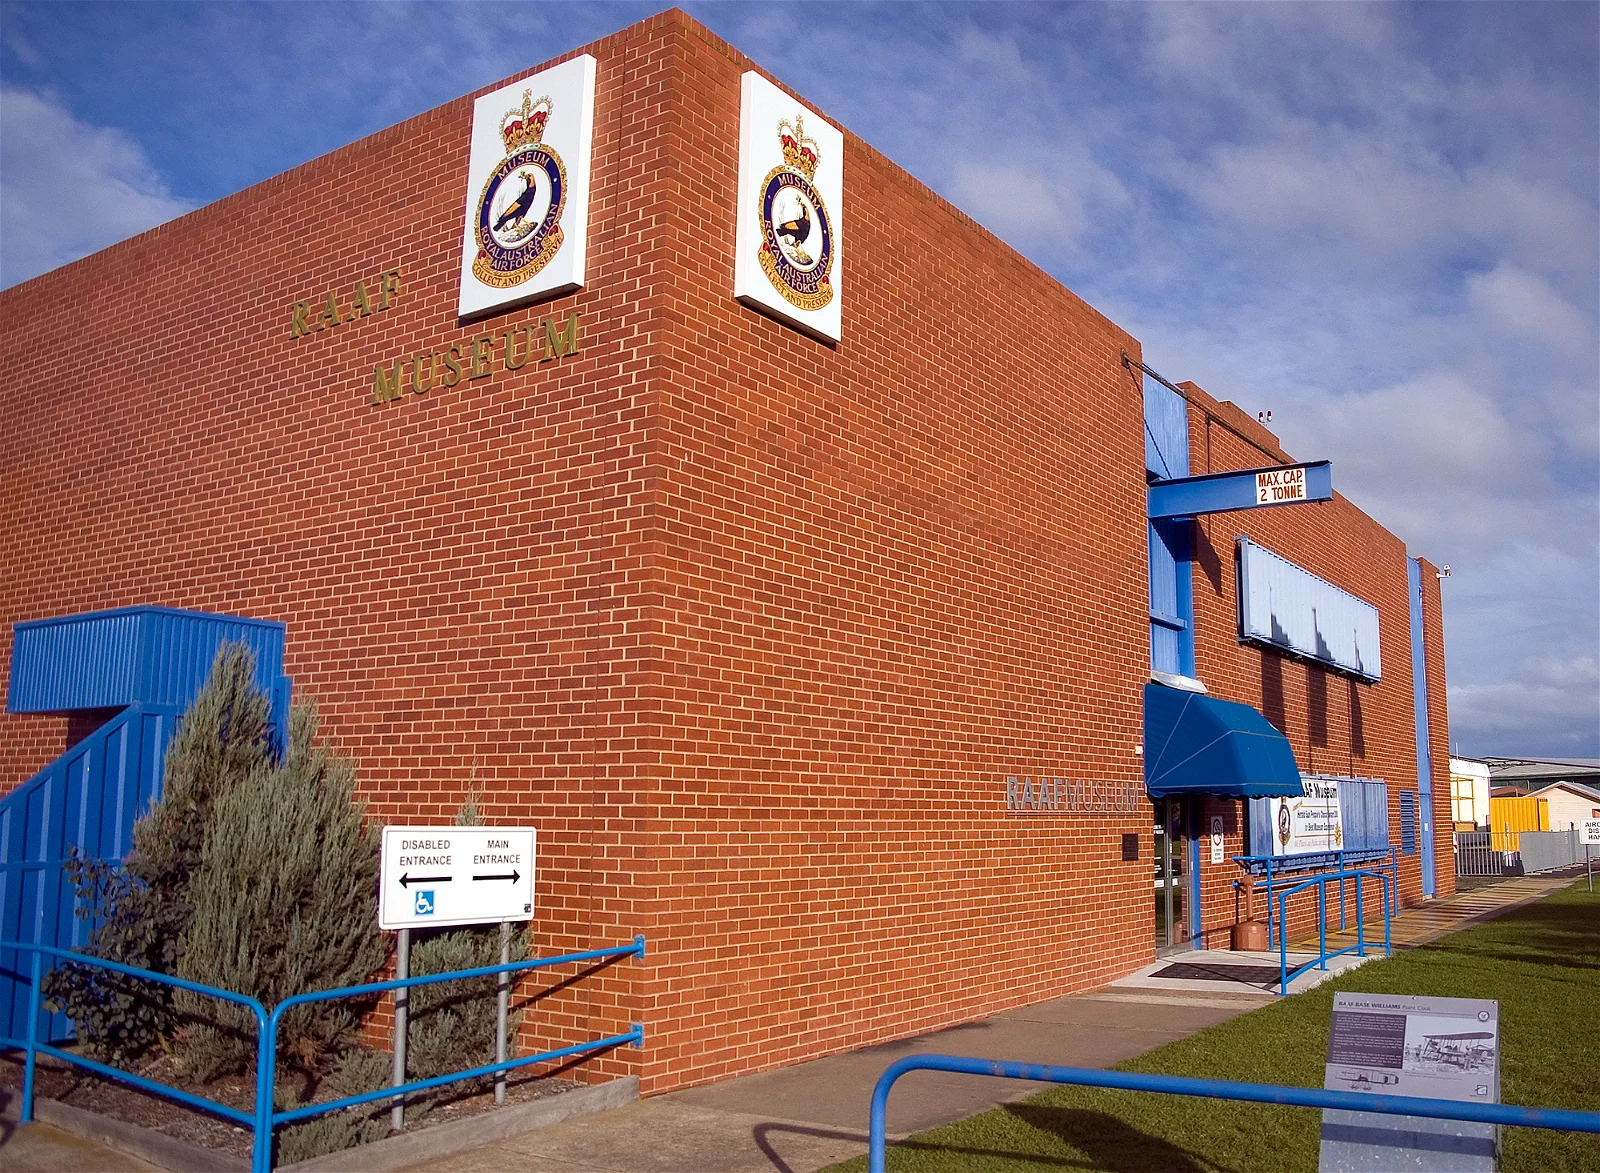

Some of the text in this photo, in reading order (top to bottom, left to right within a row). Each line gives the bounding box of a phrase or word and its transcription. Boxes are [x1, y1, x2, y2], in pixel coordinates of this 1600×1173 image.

[498, 151, 550, 181] MUSEUM
[778, 175, 821, 211] MUSEUM
[481, 203, 558, 261] ROYAL AUSTRALIAN
[472, 235, 564, 287] COLLECT AND PRESERVE
[491, 244, 543, 271] AIR FORCE
[764, 219, 829, 283] ROYAL AUSTRALIAN
[758, 251, 834, 309] COLLECT AND PRESERVE
[775, 264, 818, 294] AIR FORCE
[289, 268, 402, 340] RAAF
[370, 311, 582, 407] MUSEUM
[1260, 484, 1303, 502] 2 TONNE
[1314, 782, 1337, 799] Museum
[402, 839, 451, 850] DISABLED
[487, 839, 509, 849] MAIN
[399, 855, 452, 866] ENTRANCE
[473, 854, 521, 865] ENTRANCE
